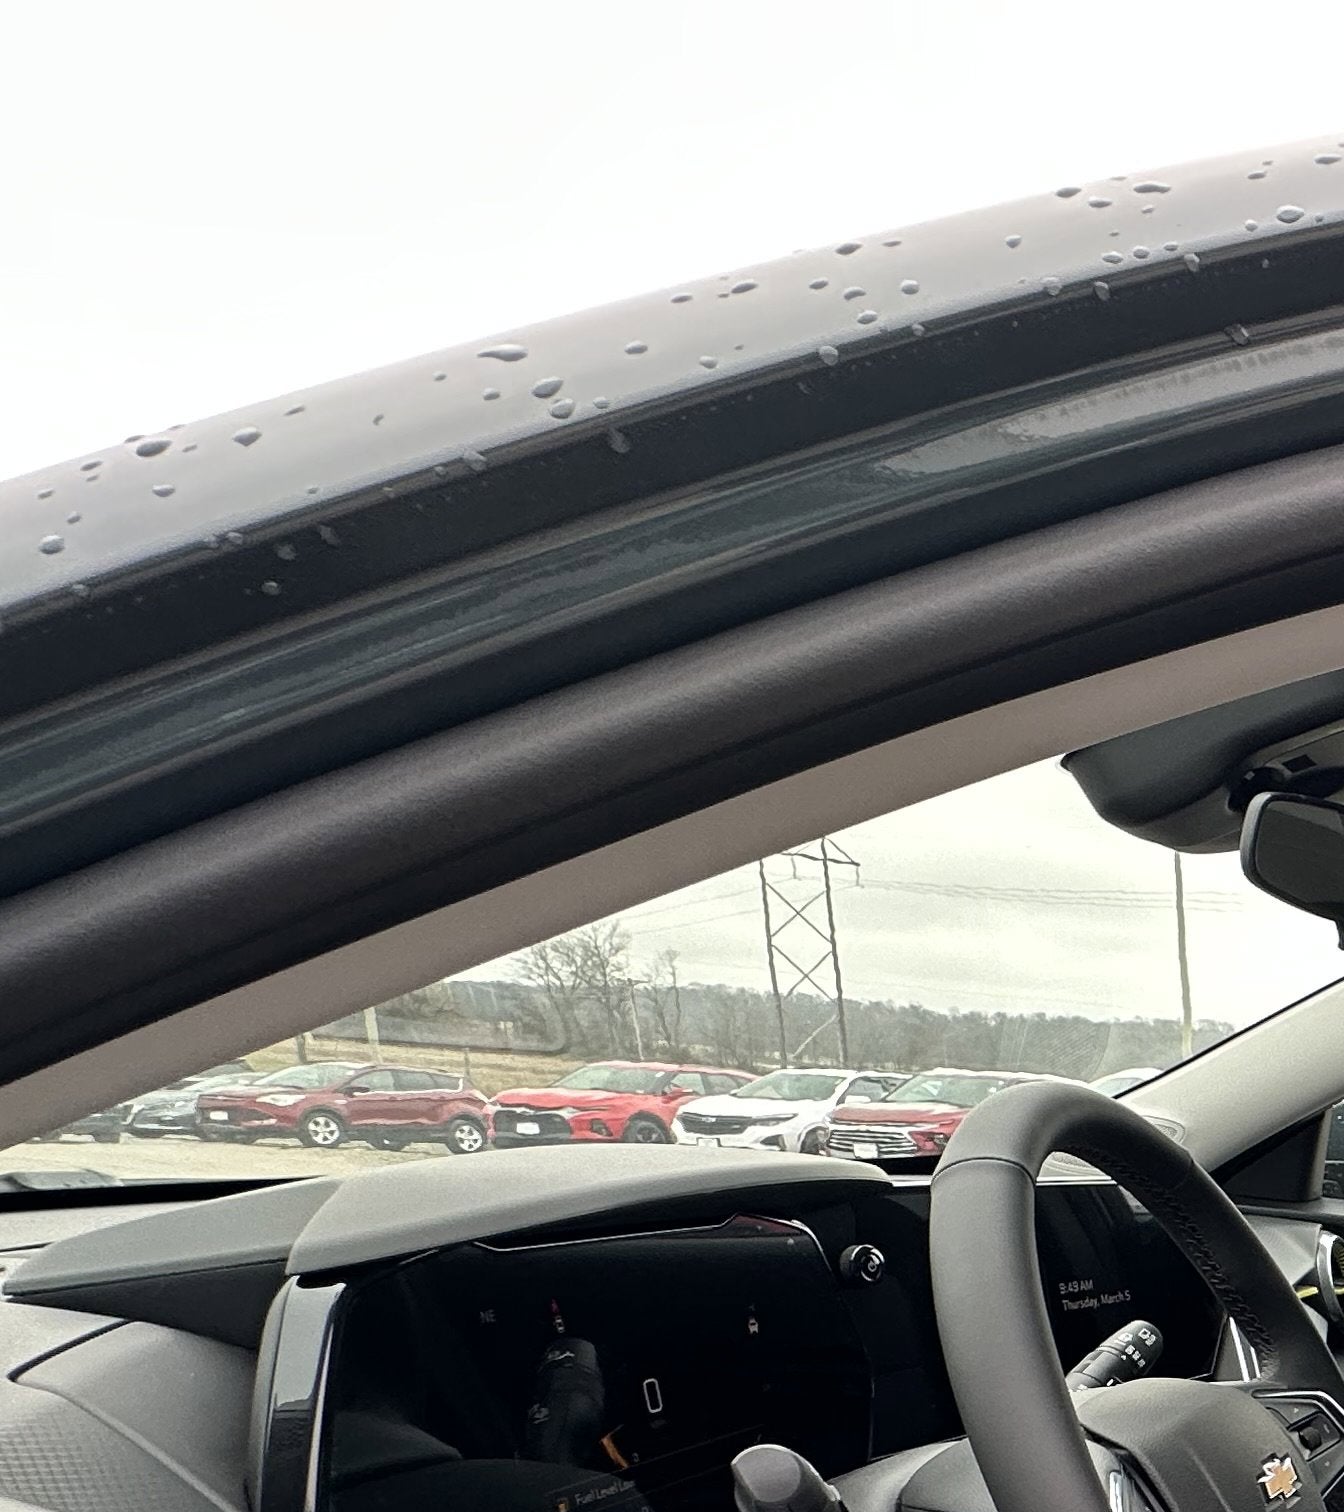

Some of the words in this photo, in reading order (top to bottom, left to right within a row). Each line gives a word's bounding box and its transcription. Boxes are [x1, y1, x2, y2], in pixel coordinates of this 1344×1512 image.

[1080, 1279, 1094, 1291] AM
[1062, 1295, 1100, 1311] Thursday,
[1100, 1291, 1124, 1305] March
